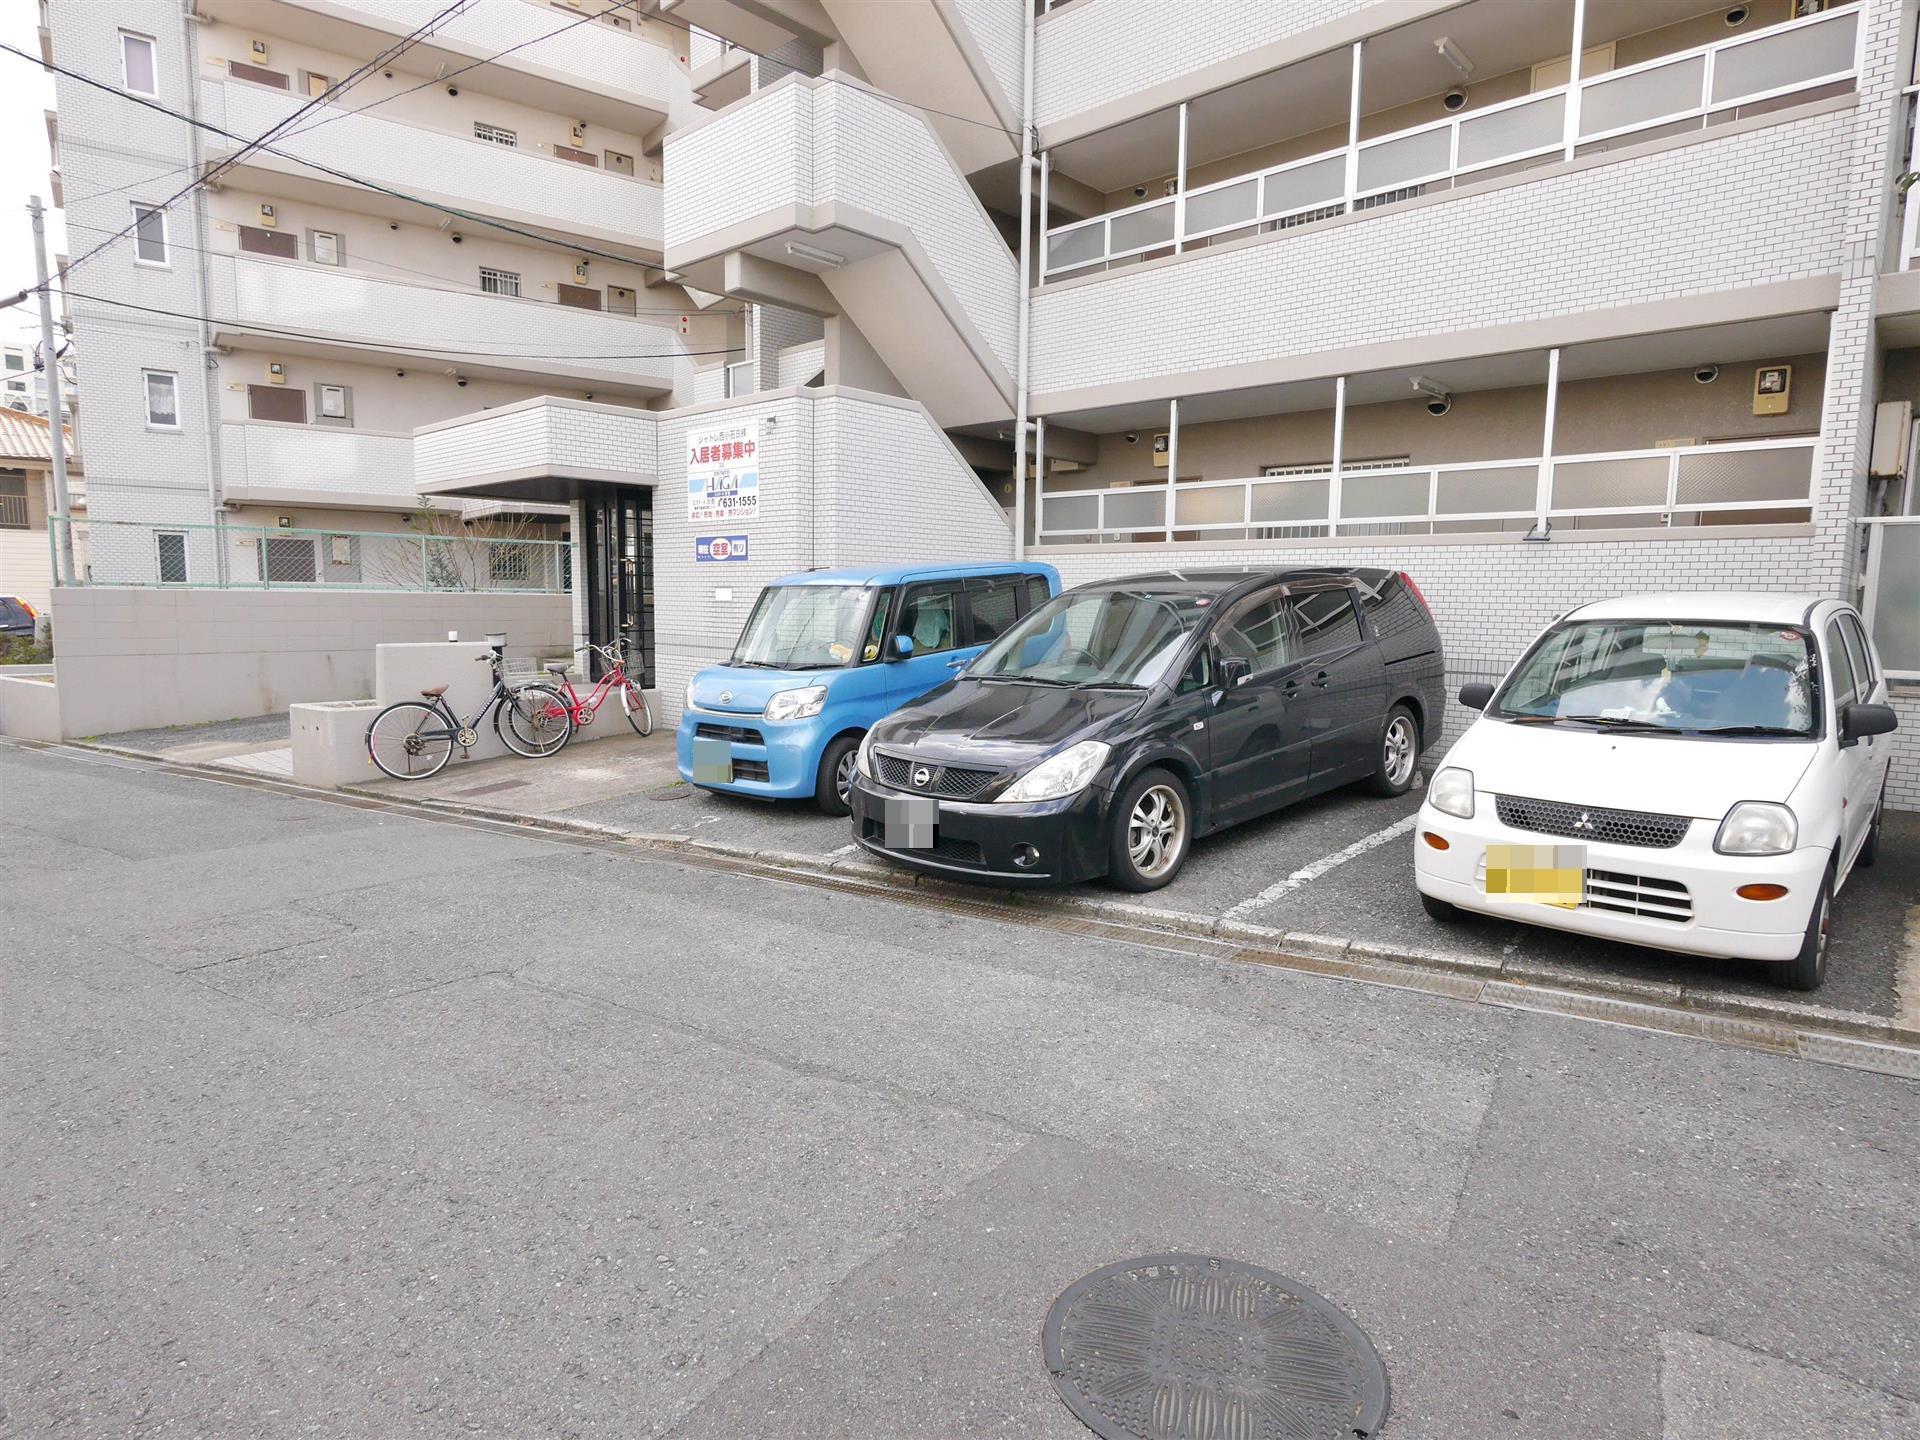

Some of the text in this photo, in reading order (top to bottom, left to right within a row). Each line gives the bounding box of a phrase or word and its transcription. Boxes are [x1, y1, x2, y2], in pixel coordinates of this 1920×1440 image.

[690, 439, 756, 465] 入居者募集中
[712, 542, 729, 556] 空室
[733, 543, 745, 554] 有り
